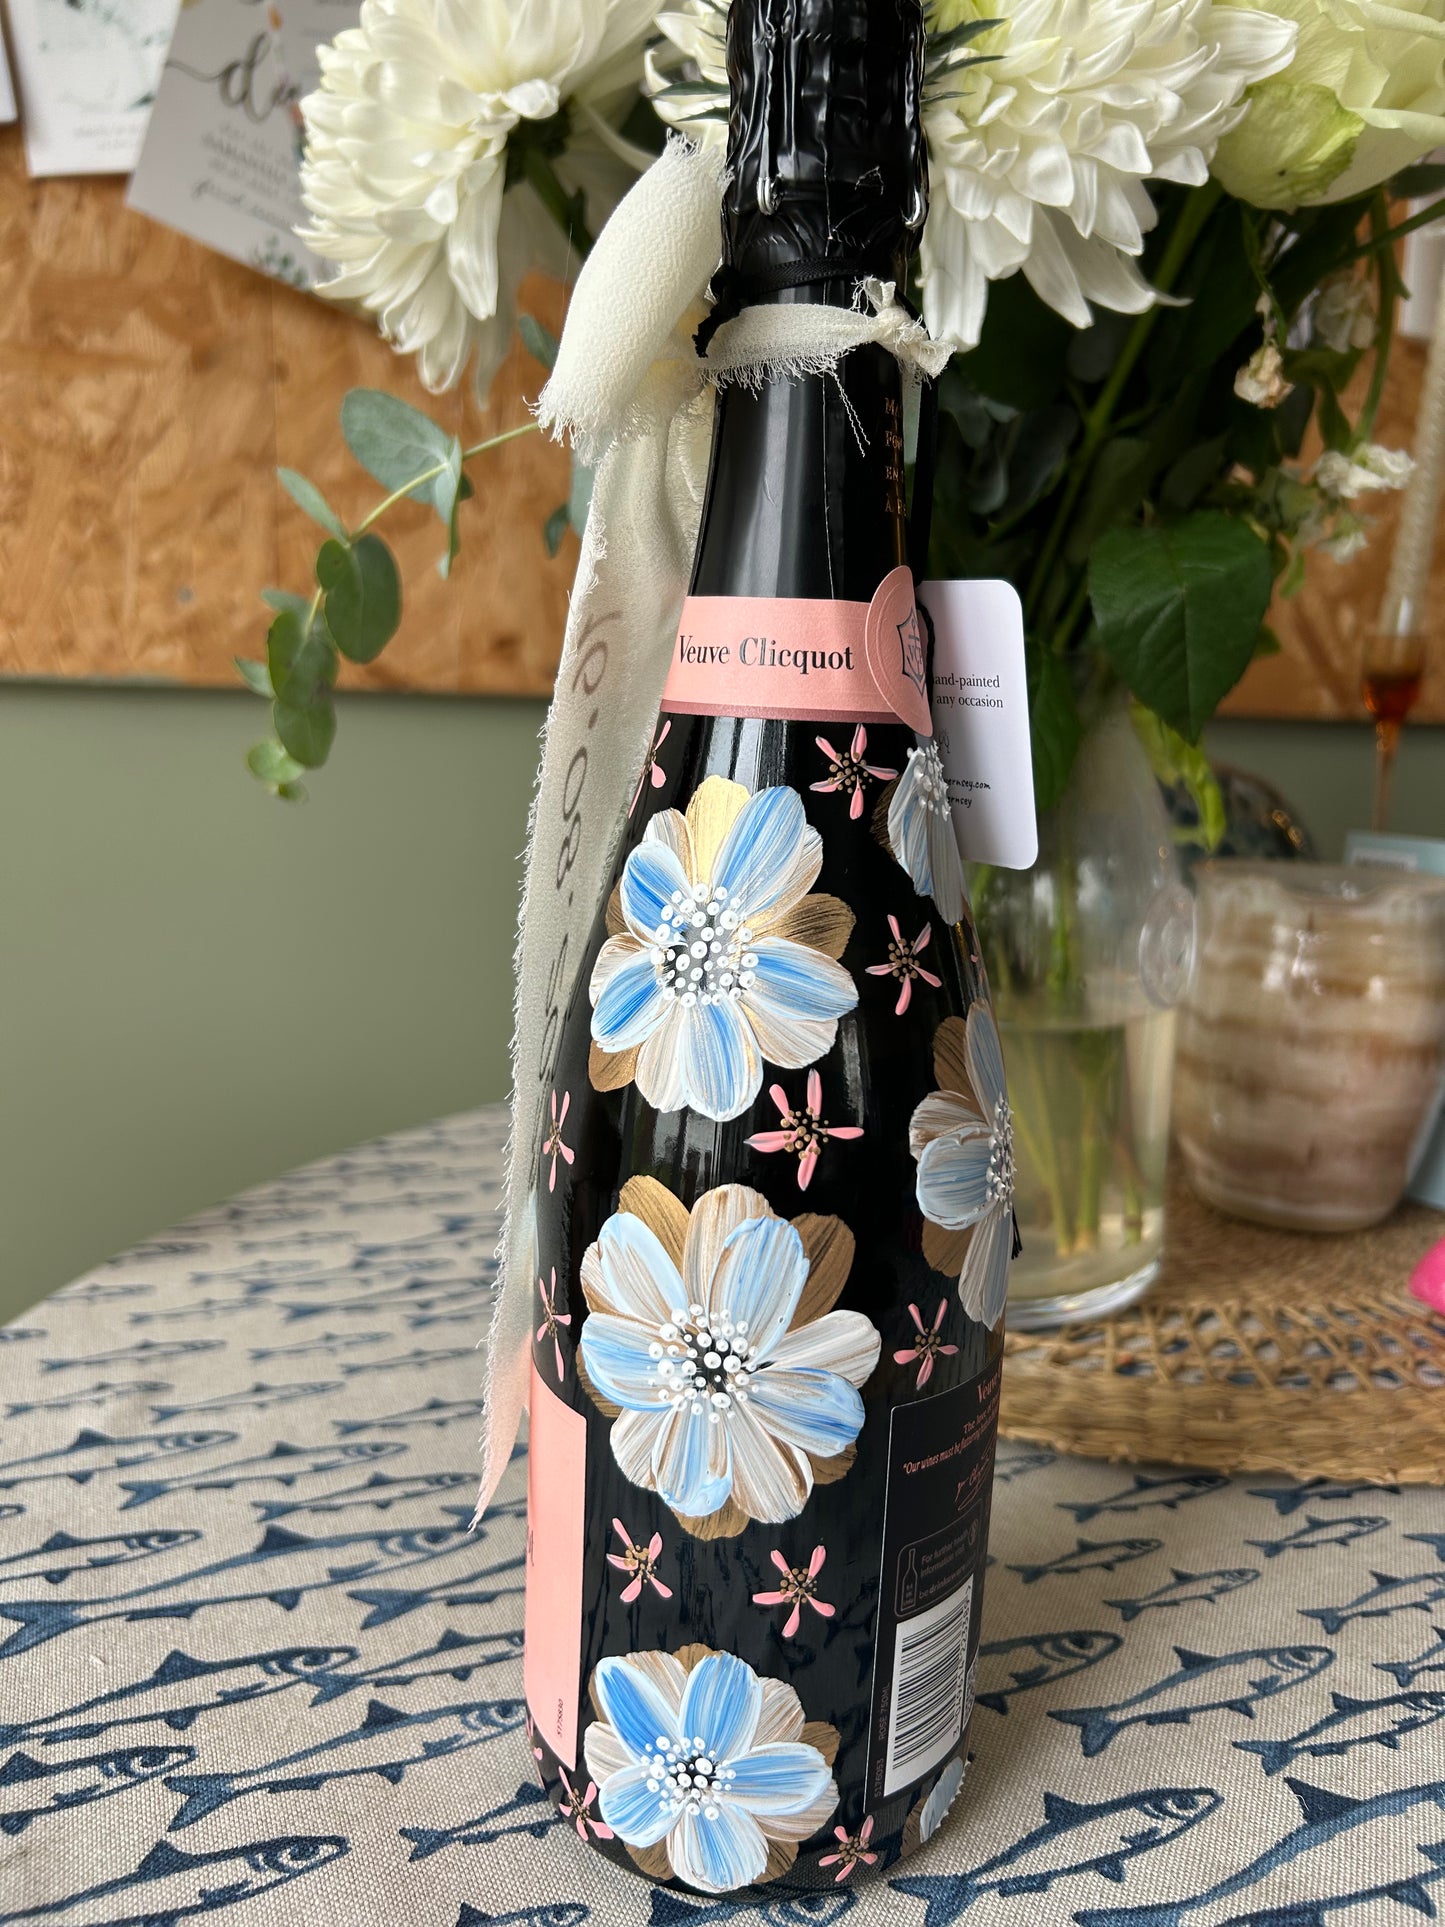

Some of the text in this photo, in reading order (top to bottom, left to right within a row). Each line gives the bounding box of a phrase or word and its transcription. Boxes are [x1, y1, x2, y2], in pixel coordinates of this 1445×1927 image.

[680, 635, 855, 675] Veuve Clicquot
[934, 673, 1000, 690] and-painted
[936, 694, 1004, 708] any occasion
[921, 1454, 940, 1470] wines
[940, 1446, 955, 1461] must
[921, 1554, 934, 1566] For
